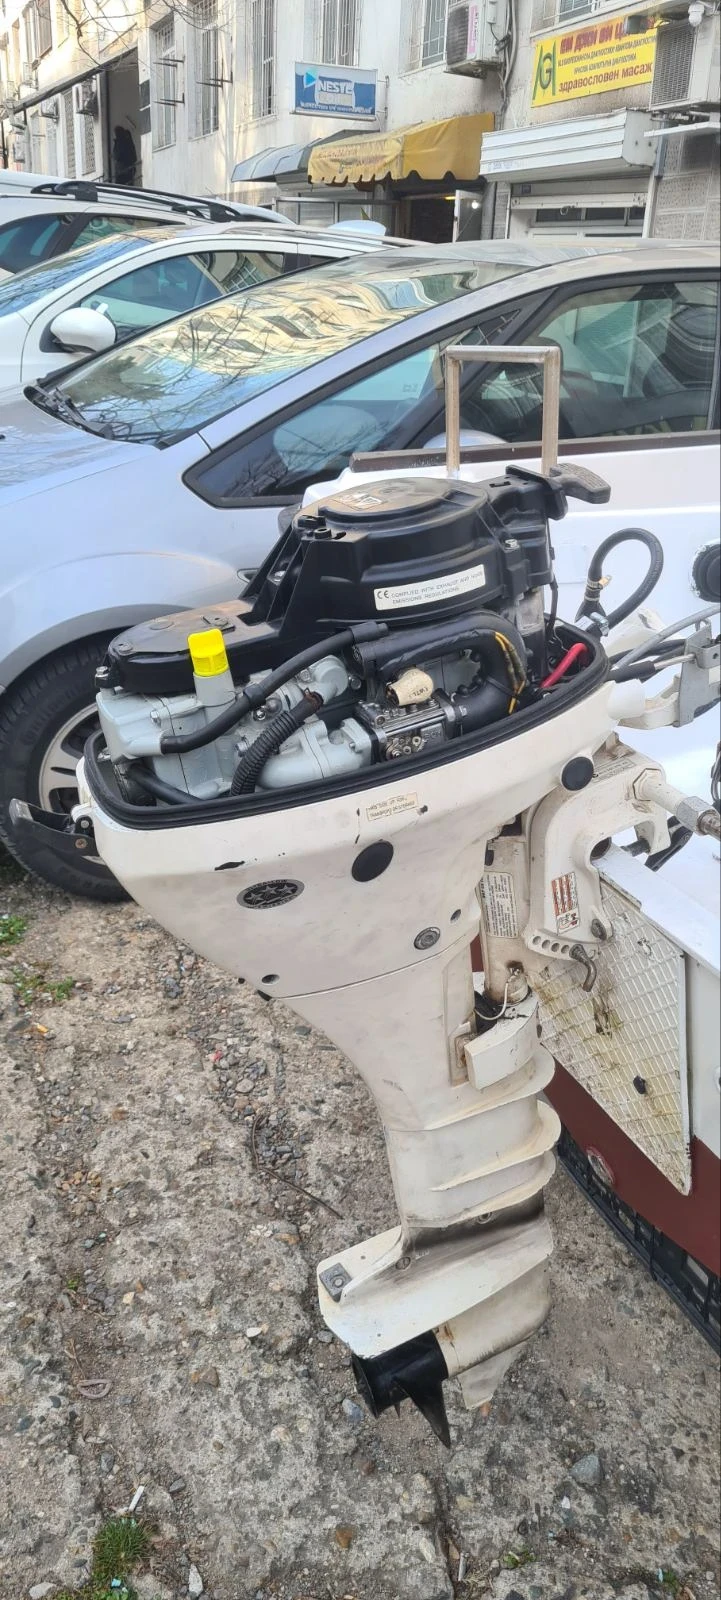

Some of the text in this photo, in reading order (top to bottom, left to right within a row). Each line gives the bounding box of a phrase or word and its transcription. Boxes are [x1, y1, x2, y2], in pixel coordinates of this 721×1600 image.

[559, 62, 653, 93] здравословен масаж
[436, 580, 458, 590] EXHAUST
[425, 587, 460, 598] REGULATIONS
